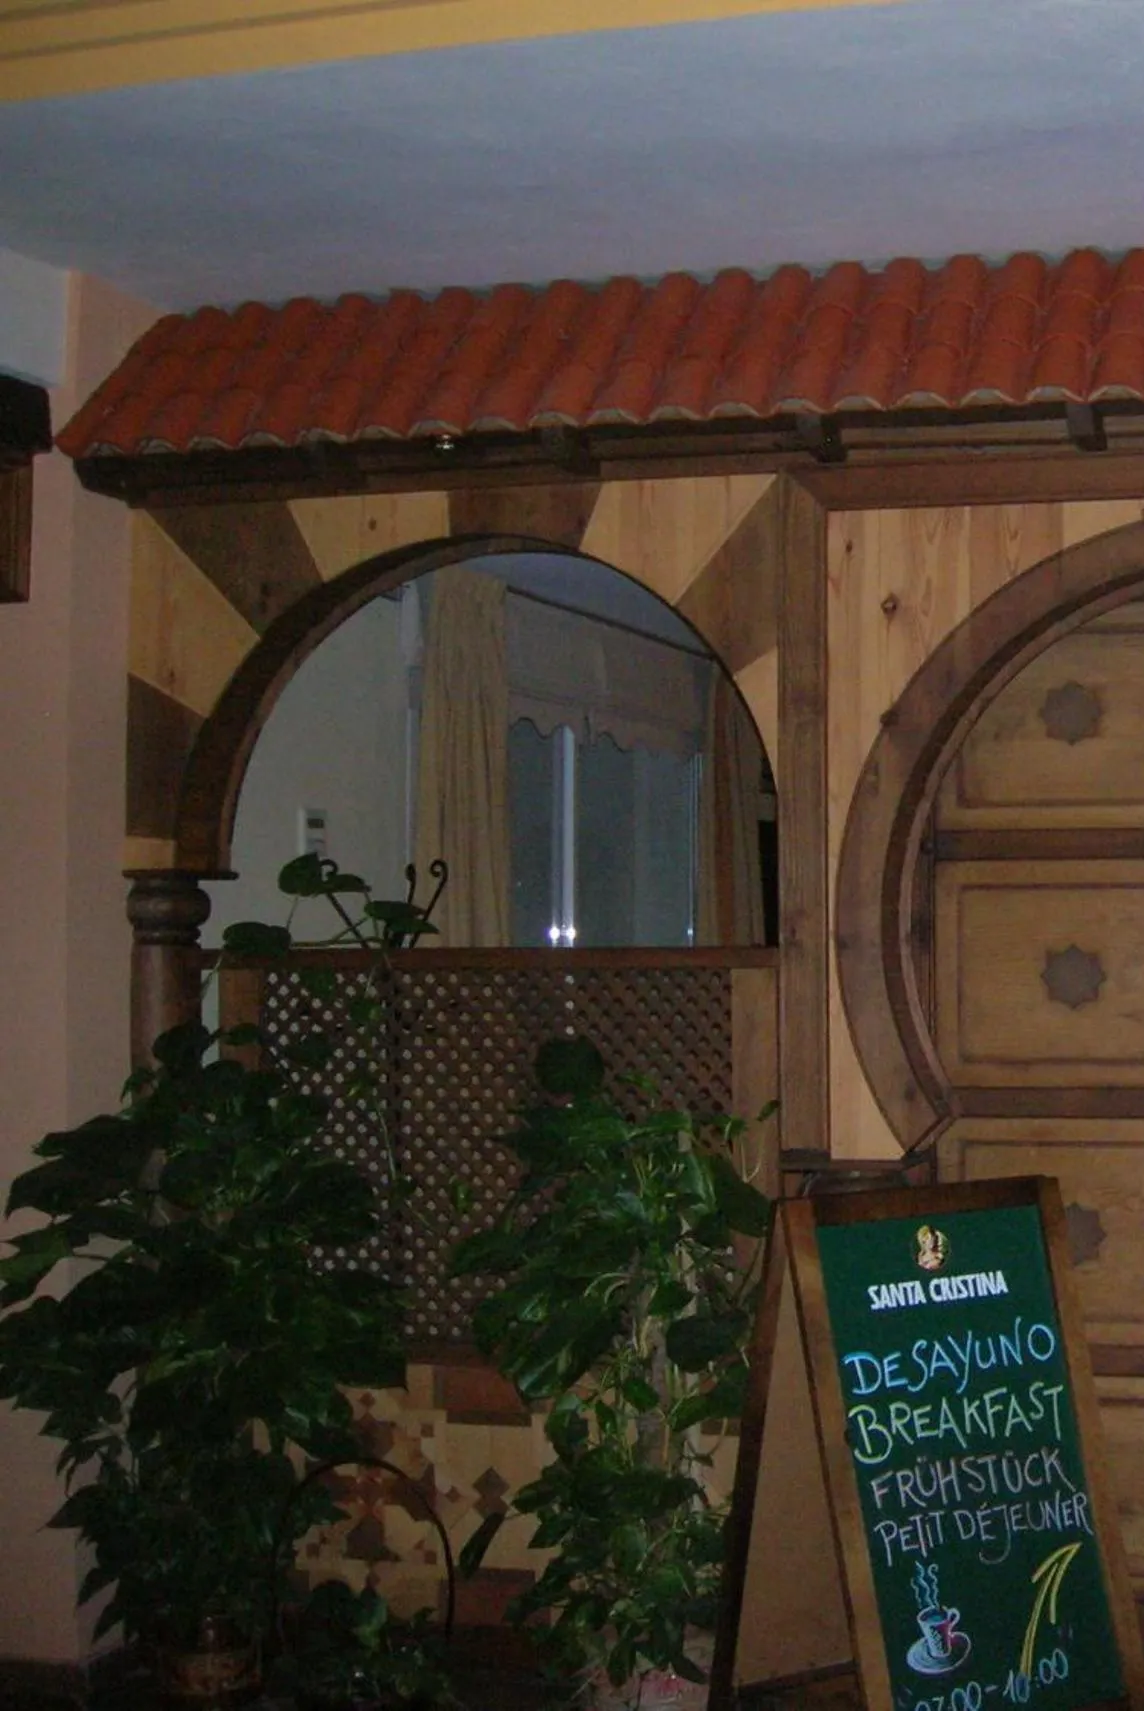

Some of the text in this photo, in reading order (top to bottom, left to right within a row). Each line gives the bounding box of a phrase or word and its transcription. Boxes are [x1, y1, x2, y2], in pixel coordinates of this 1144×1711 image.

[867, 1270, 1009, 1310] SANTA CRISTINA
[843, 1316, 1055, 1395] DESAYUNO
[848, 1381, 1064, 1465] BREAKFAST
[870, 1446, 1077, 1509] FRÜHSTÜCK
[953, 1491, 1094, 1565] DÉJEUNER
